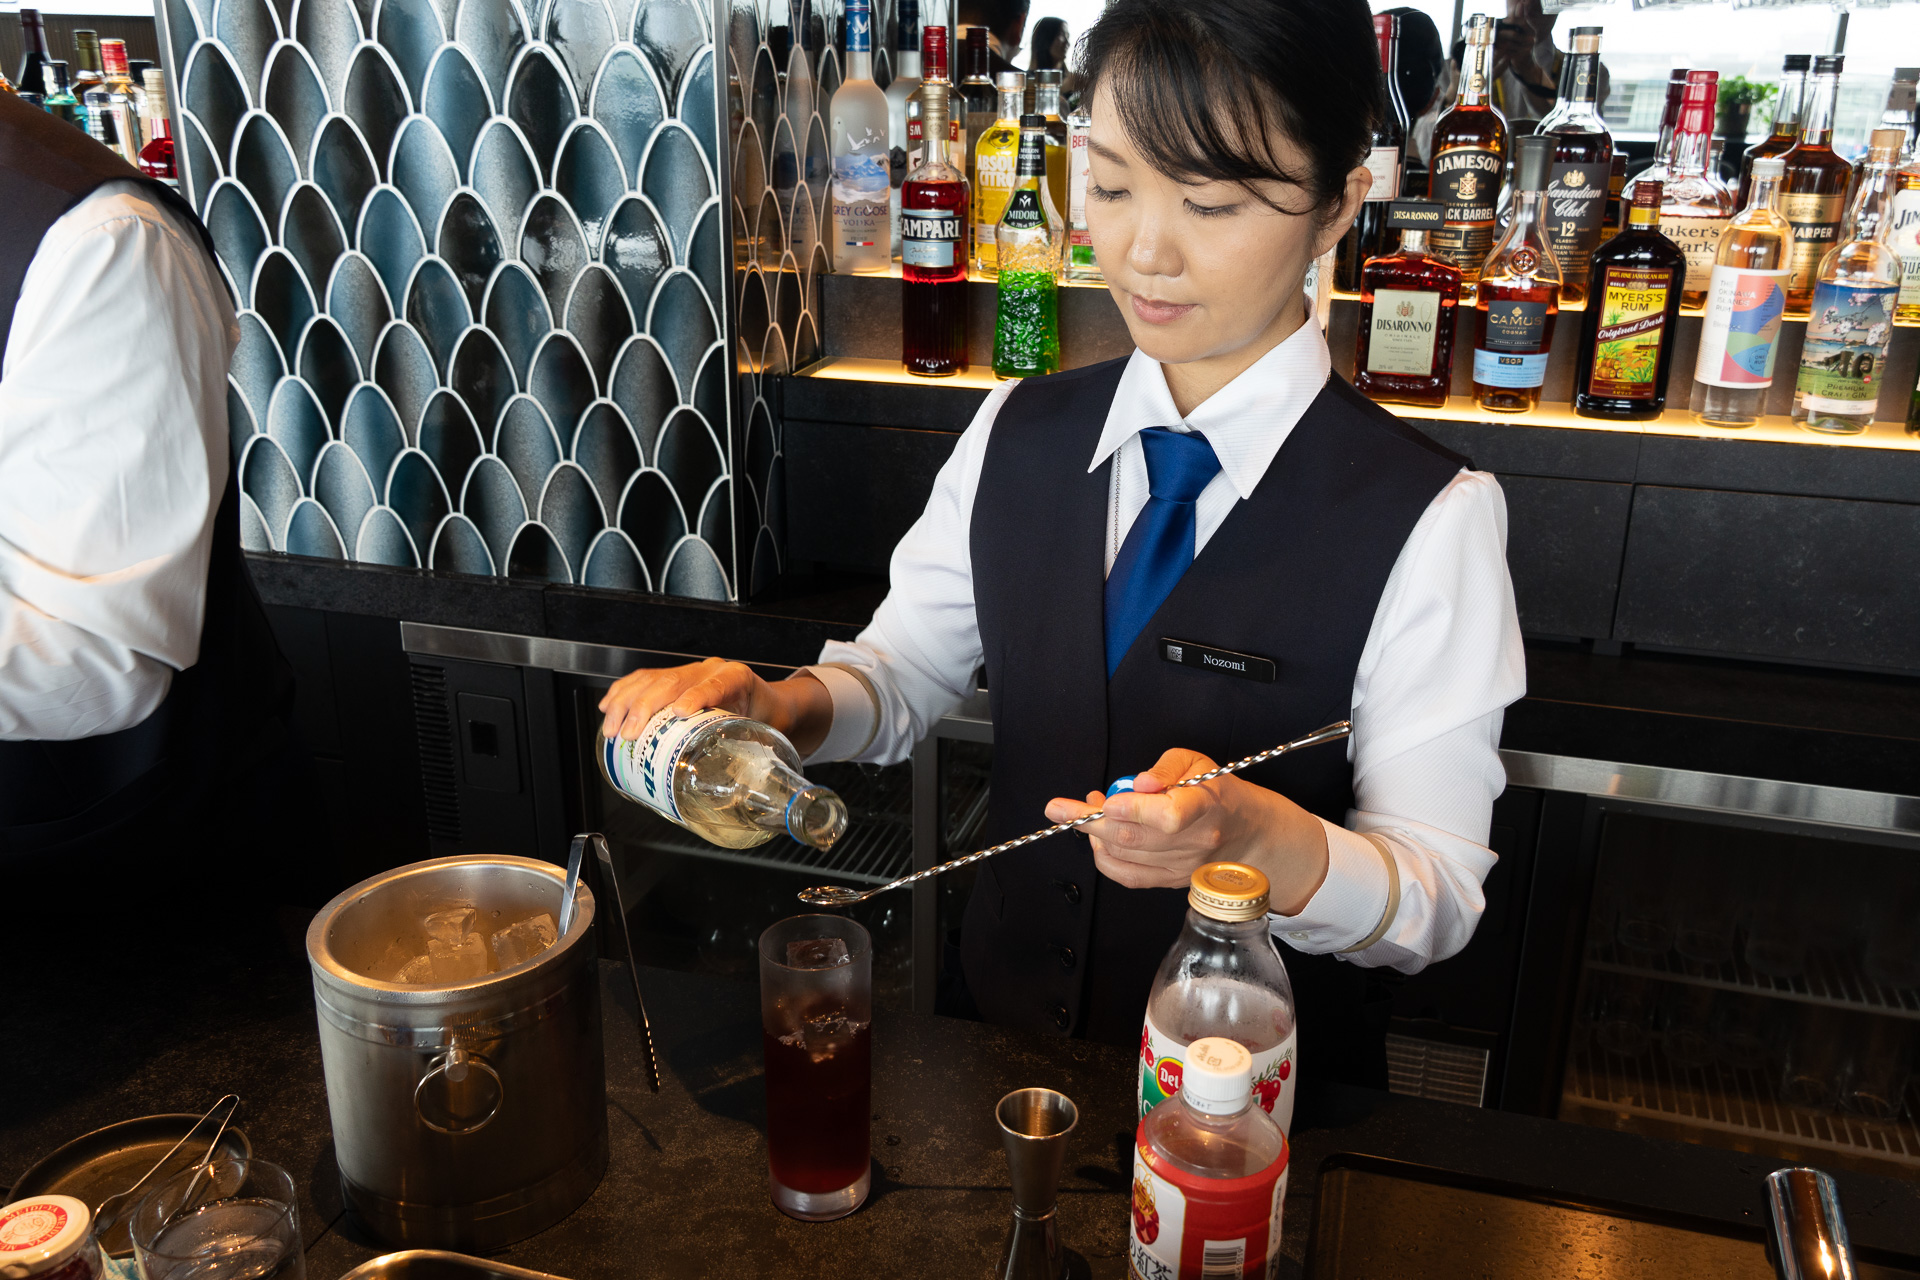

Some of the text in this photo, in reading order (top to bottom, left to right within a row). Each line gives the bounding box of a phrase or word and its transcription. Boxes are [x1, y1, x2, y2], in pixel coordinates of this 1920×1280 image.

[976, 154, 1018, 171] ABSOL
[1019, 153, 1041, 161] LIQUEUR
[1436, 154, 1501, 175] JAMESON
[979, 170, 1016, 188] CITRO
[1547, 179, 1602, 199] Canadian
[854, 204, 889, 217] GOOSE
[1462, 208, 1494, 221] BARREL
[1552, 198, 1590, 217] Club
[1008, 210, 1039, 220] MIDORI
[1393, 210, 1440, 221] DISARONNO
[901, 217, 960, 239] AMPARI
[1560, 221, 1576, 237] 12
[1659, 224, 1720, 238] aker's
[1675, 240, 1715, 253] ark
[1608, 291, 1664, 303] MYERS'S
[1620, 301, 1649, 312] RUM
[1376, 318, 1432, 333] DISARONNO
[1489, 313, 1543, 327] CAMUS
[1597, 314, 1664, 341] Original Dark
[1499, 356, 1522, 365] VSOP
[1202, 653, 1247, 672] Nozomi
[1160, 1067, 1180, 1089] Del
